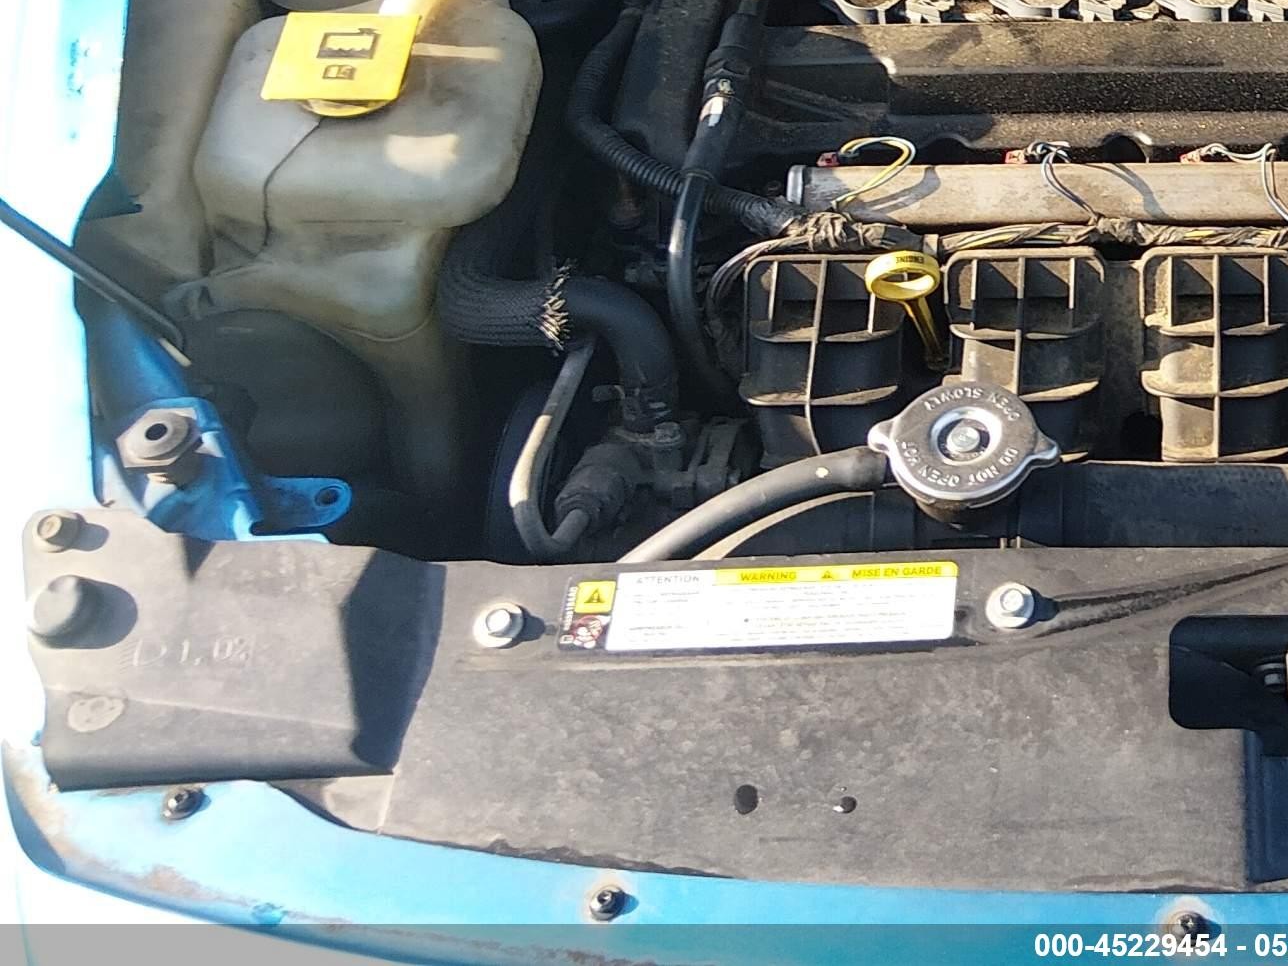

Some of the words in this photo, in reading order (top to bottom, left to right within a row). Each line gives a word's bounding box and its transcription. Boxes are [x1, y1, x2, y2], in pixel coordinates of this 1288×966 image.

[923, 387, 984, 411] SLOWLY
[987, 392, 1021, 422] OPEN
[998, 447, 1019, 466] DO
[918, 465, 960, 487] OPEN
[968, 464, 1000, 486] NOT
[637, 575, 700, 584] ATTENTION
[740, 571, 797, 582] WARNING
[852, 567, 880, 579] MISE
[883, 567, 900, 577] EN
[903, 566, 942, 576] GARDE
